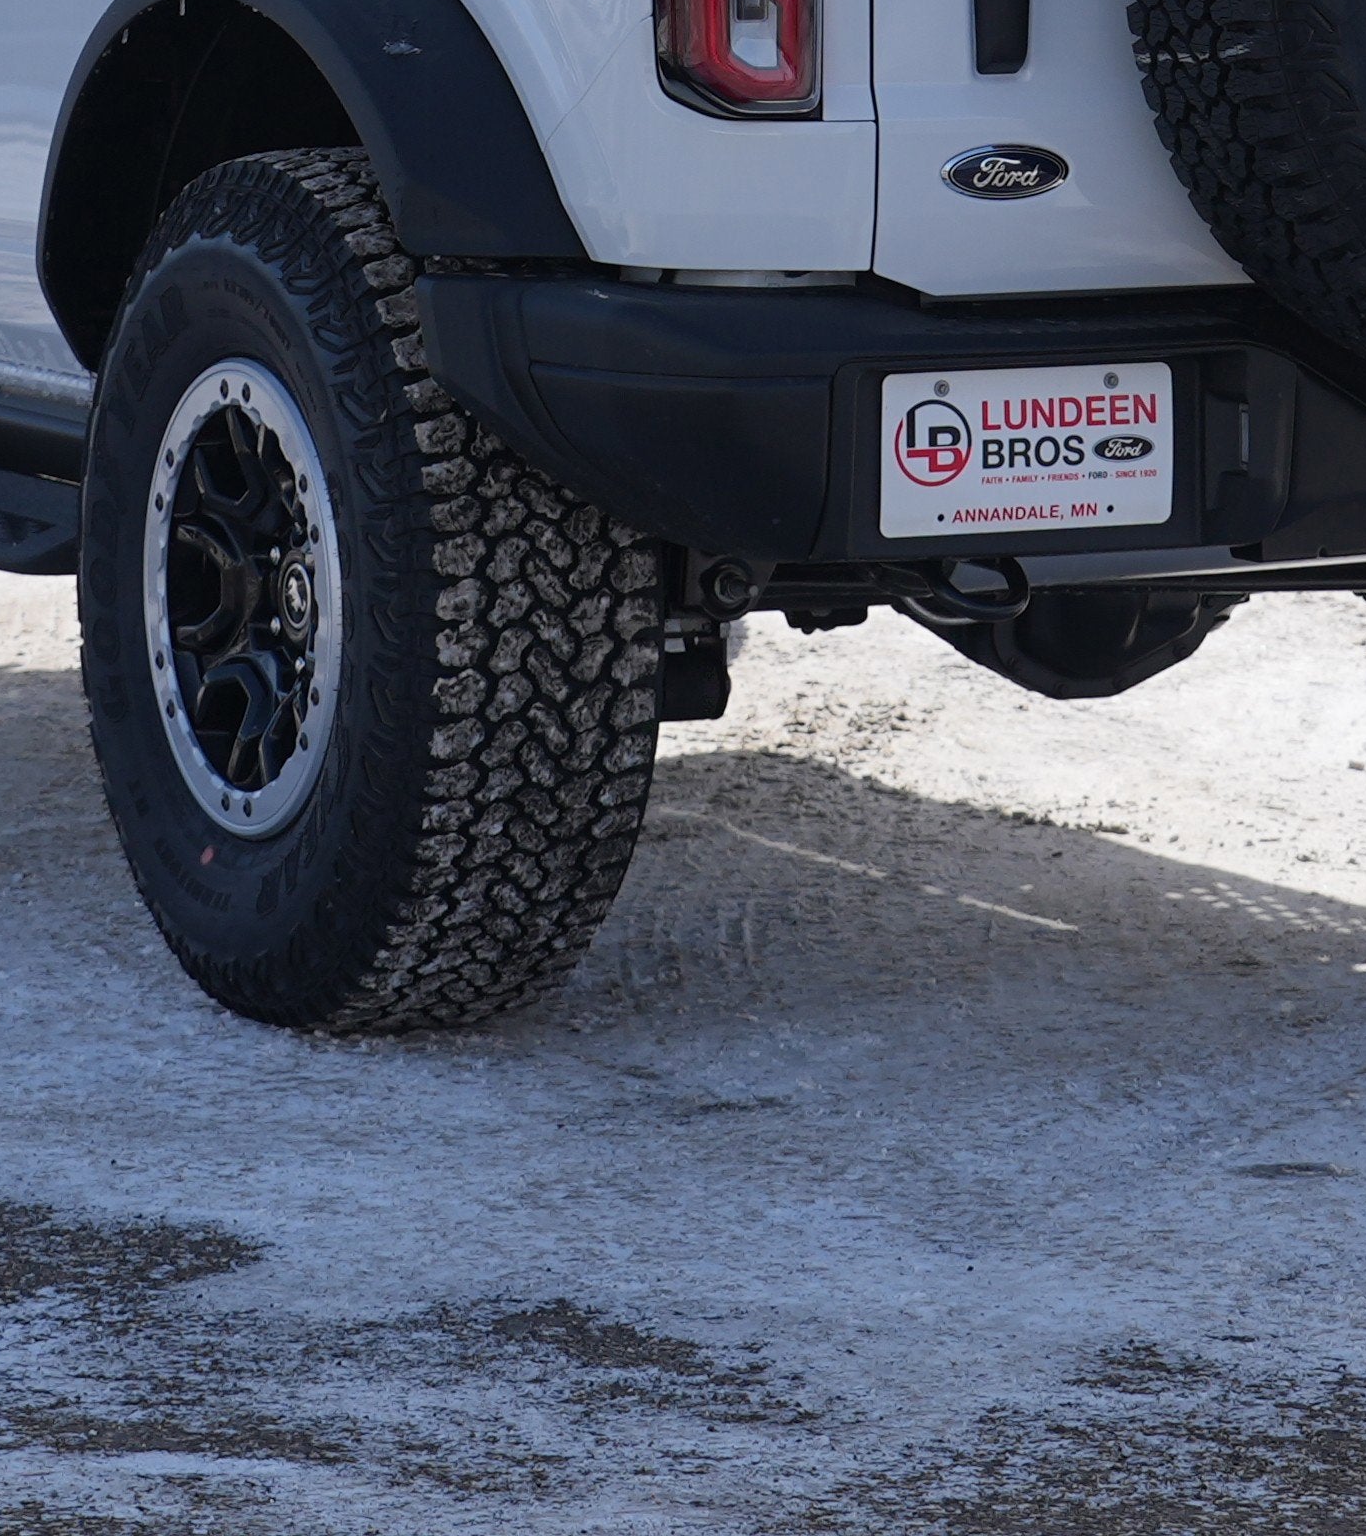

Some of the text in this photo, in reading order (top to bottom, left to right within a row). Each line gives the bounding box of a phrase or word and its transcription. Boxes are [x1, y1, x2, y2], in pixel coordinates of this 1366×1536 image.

[972, 156, 1041, 189] Ford
[981, 393, 1157, 431] LUNDEEN
[982, 435, 1085, 470] BROS
[981, 476, 1004, 485] FAITH
[1012, 474, 1038, 484] FAMILY
[1047, 472, 1079, 482] FRIENDS
[1088, 470, 1108, 480] FORD
[1115, 469, 1137, 479] SINCE
[951, 502, 1098, 524] ANNANDALE, MN
